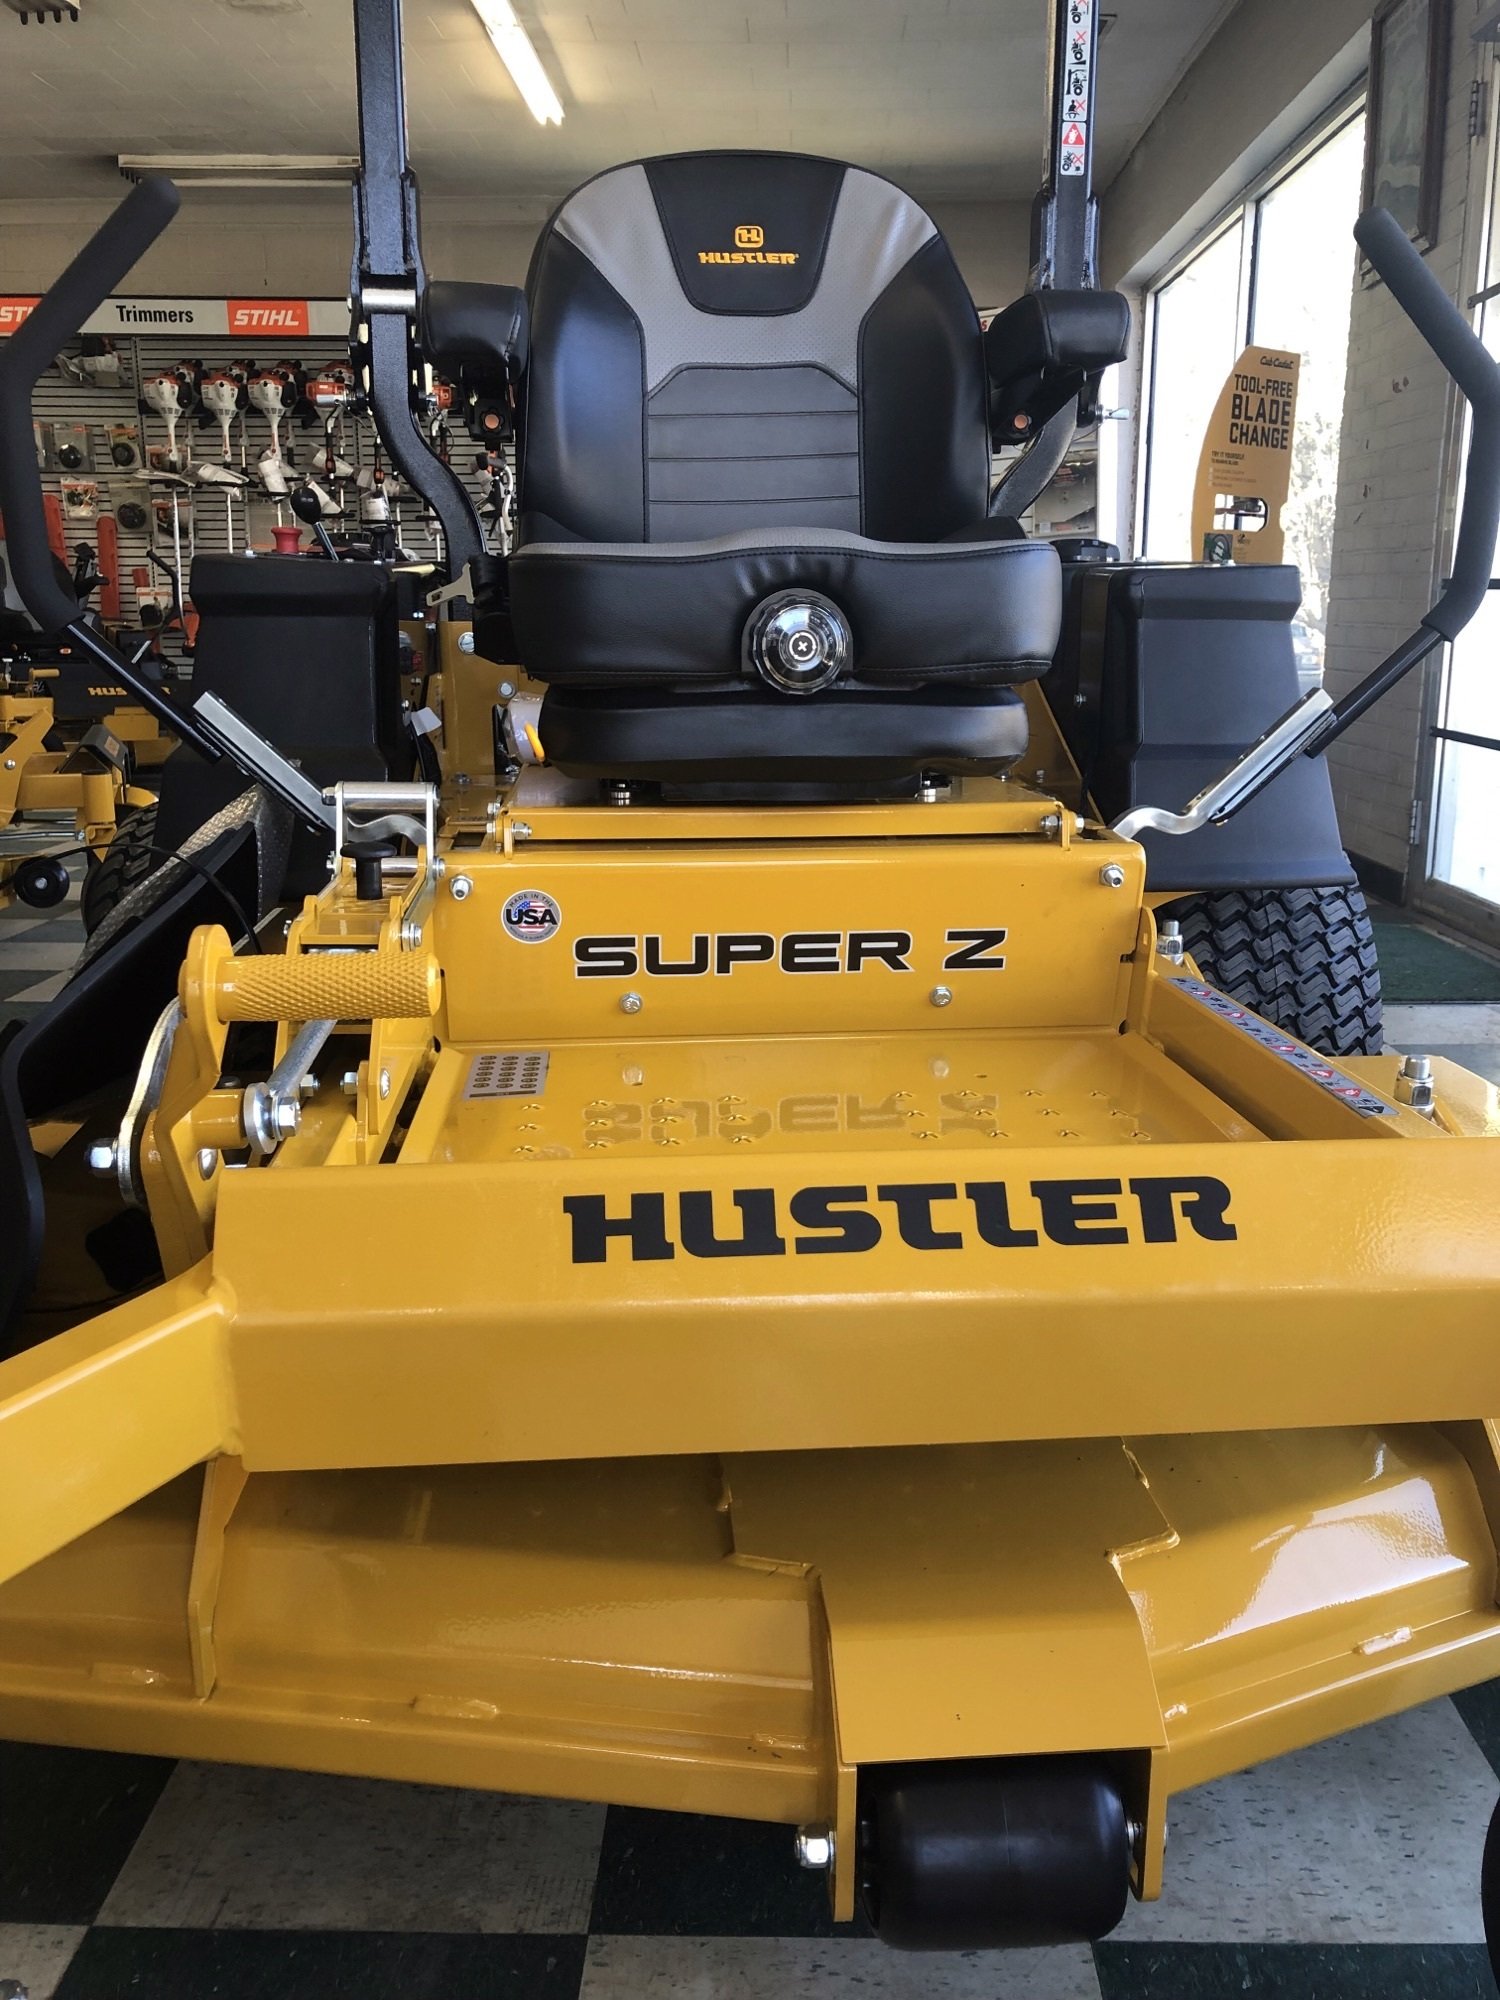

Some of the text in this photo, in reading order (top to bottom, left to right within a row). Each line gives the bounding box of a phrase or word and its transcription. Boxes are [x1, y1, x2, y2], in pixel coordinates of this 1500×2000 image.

[698, 252, 797, 265] HUSTLER
[115, 305, 194, 323] Trimmers
[234, 309, 300, 326] STIHL
[1234, 374, 1293, 399] TOOL-FREE
[1231, 393, 1291, 426] BLADE
[1229, 422, 1289, 450] CHANGE
[509, 894, 528, 907] MADE
[542, 896, 554, 907] THE
[506, 909, 558, 925] USA
[573, 928, 1008, 978] SUPER Z
[563, 1175, 1238, 1264] HUSTLER
